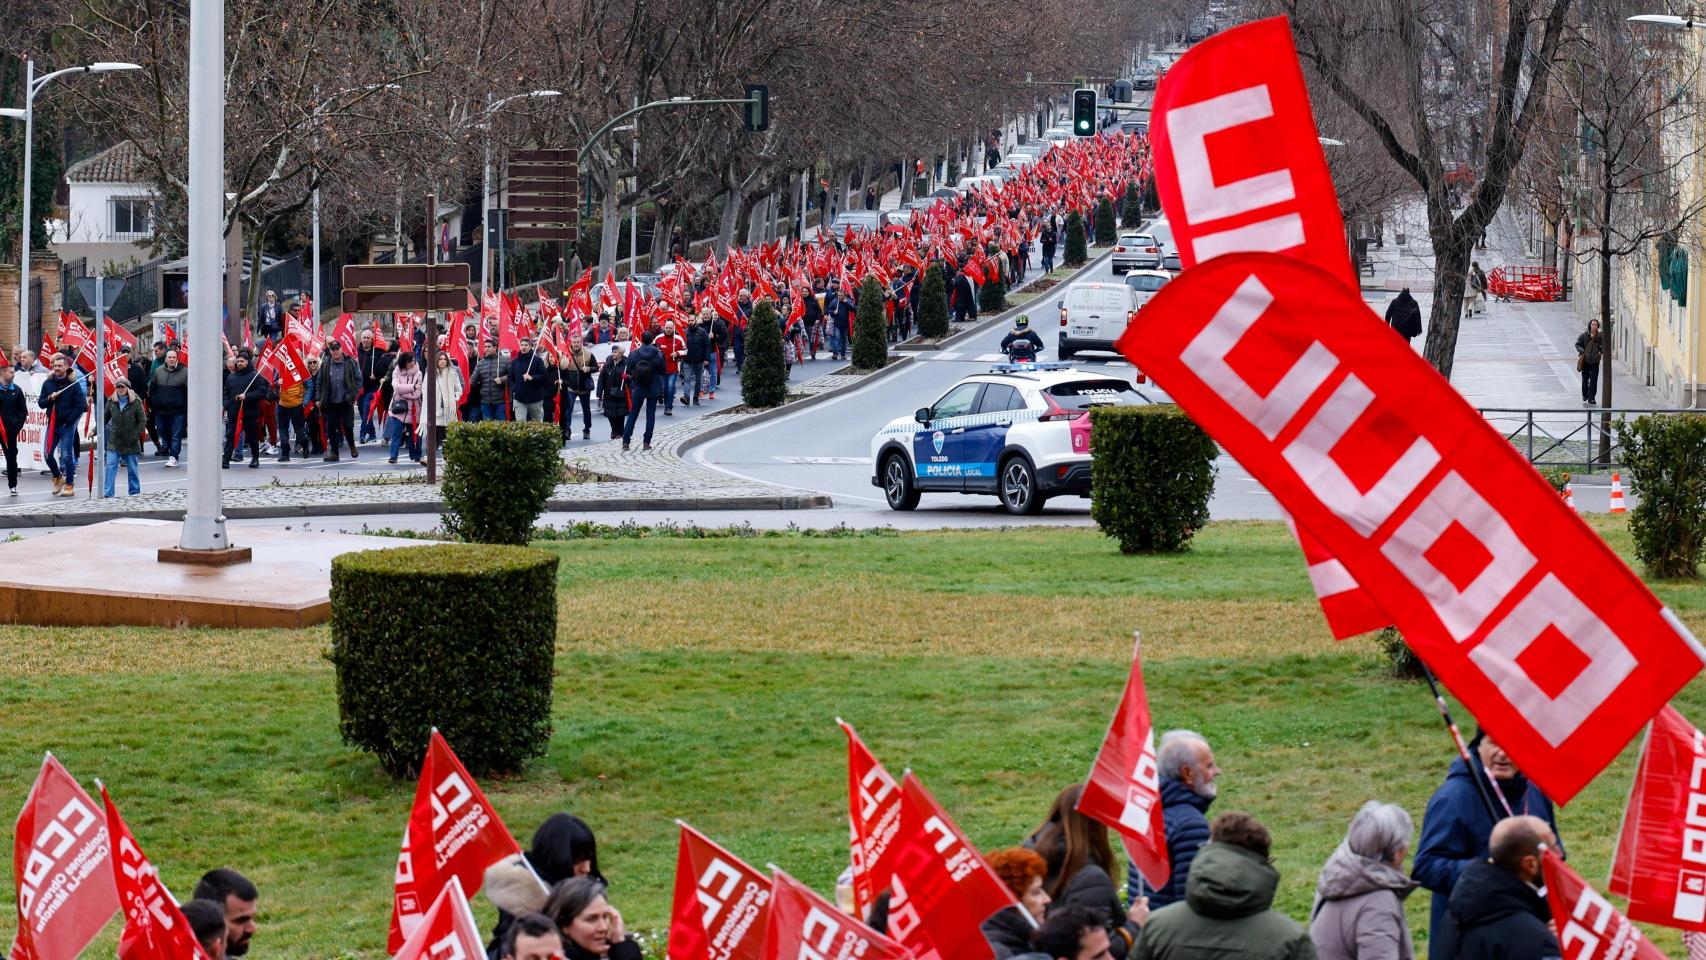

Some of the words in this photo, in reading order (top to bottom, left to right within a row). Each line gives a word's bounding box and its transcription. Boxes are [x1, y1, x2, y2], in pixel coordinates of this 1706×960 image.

[1077, 388, 1119, 396] POLICIA
[927, 465, 962, 476] POLICIA
[1180, 273, 1639, 749] CCOO
